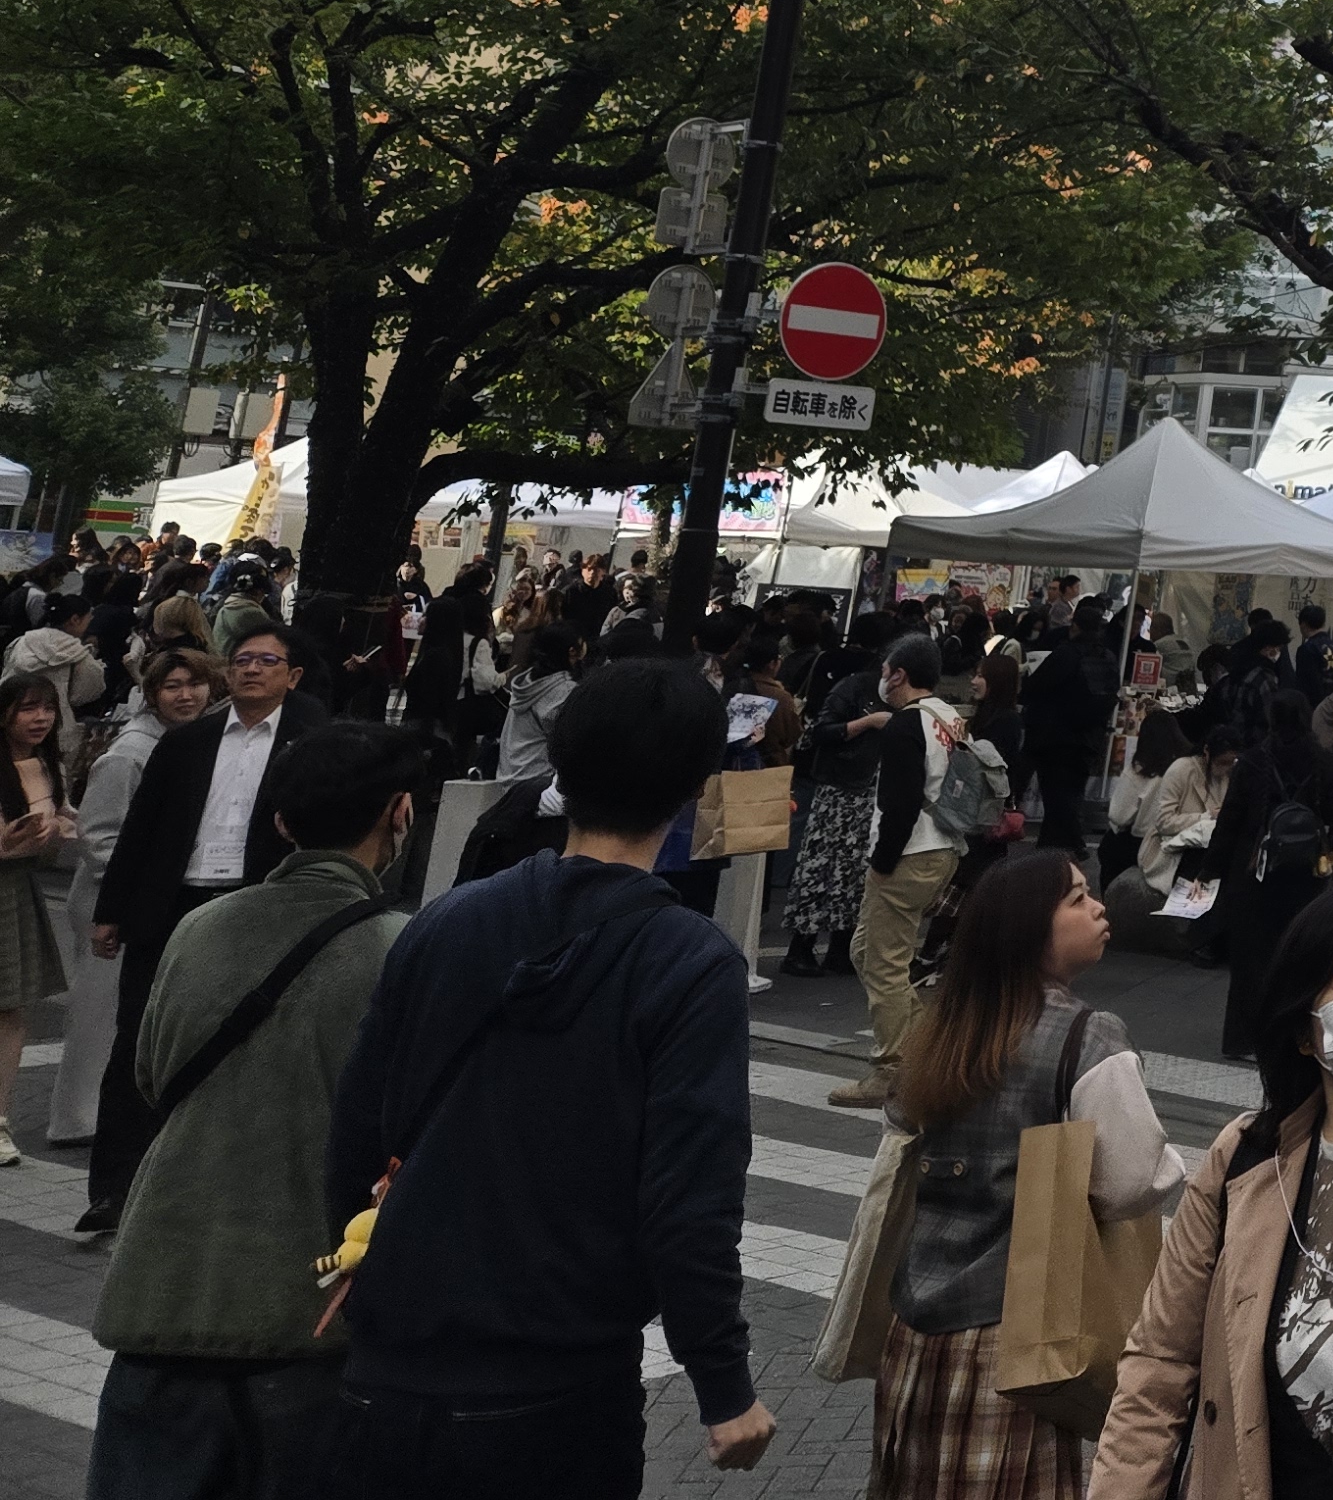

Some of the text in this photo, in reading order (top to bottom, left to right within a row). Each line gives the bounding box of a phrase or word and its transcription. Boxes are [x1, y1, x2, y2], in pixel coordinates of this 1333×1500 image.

[772, 389, 869, 421] 自転車を除く
